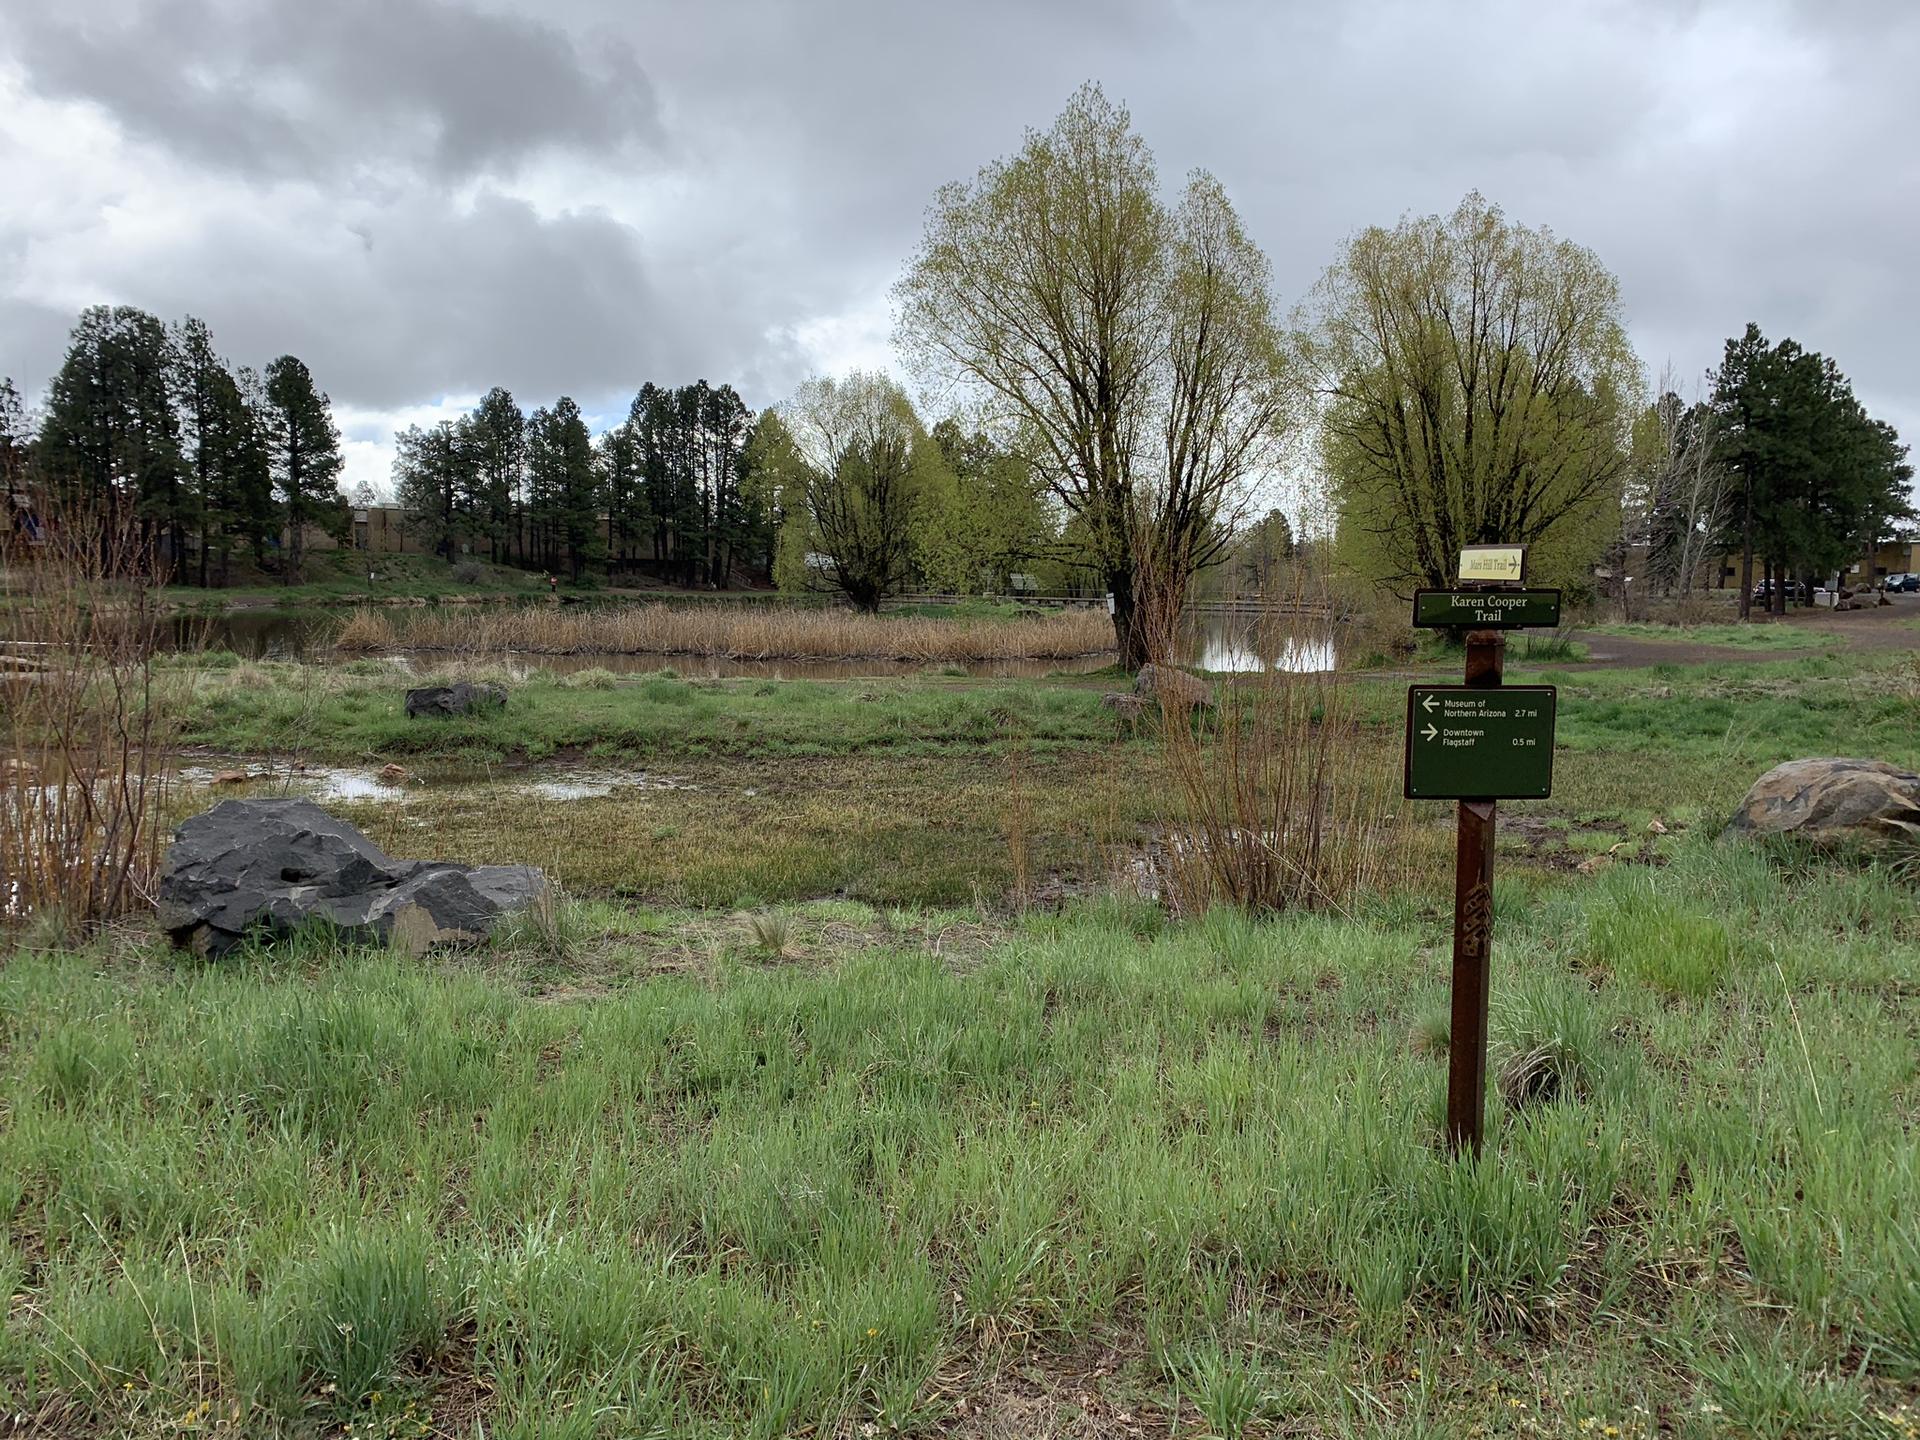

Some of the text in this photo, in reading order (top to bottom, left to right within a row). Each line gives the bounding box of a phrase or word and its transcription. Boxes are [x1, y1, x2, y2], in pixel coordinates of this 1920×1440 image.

[1493, 559, 1508, 570] Trail
[1451, 595, 1528, 610] Karen Cooper
[1475, 609, 1502, 621] Trail
[1444, 700, 1486, 708] Museum of
[1444, 709, 1506, 717] Northern Arizona
[1515, 709, 1537, 717] 2.7 mi
[1443, 729, 1485, 737] Downtown
[1443, 738, 1475, 747] Flagstaff
[1512, 738, 1536, 746] 0.5 mi
